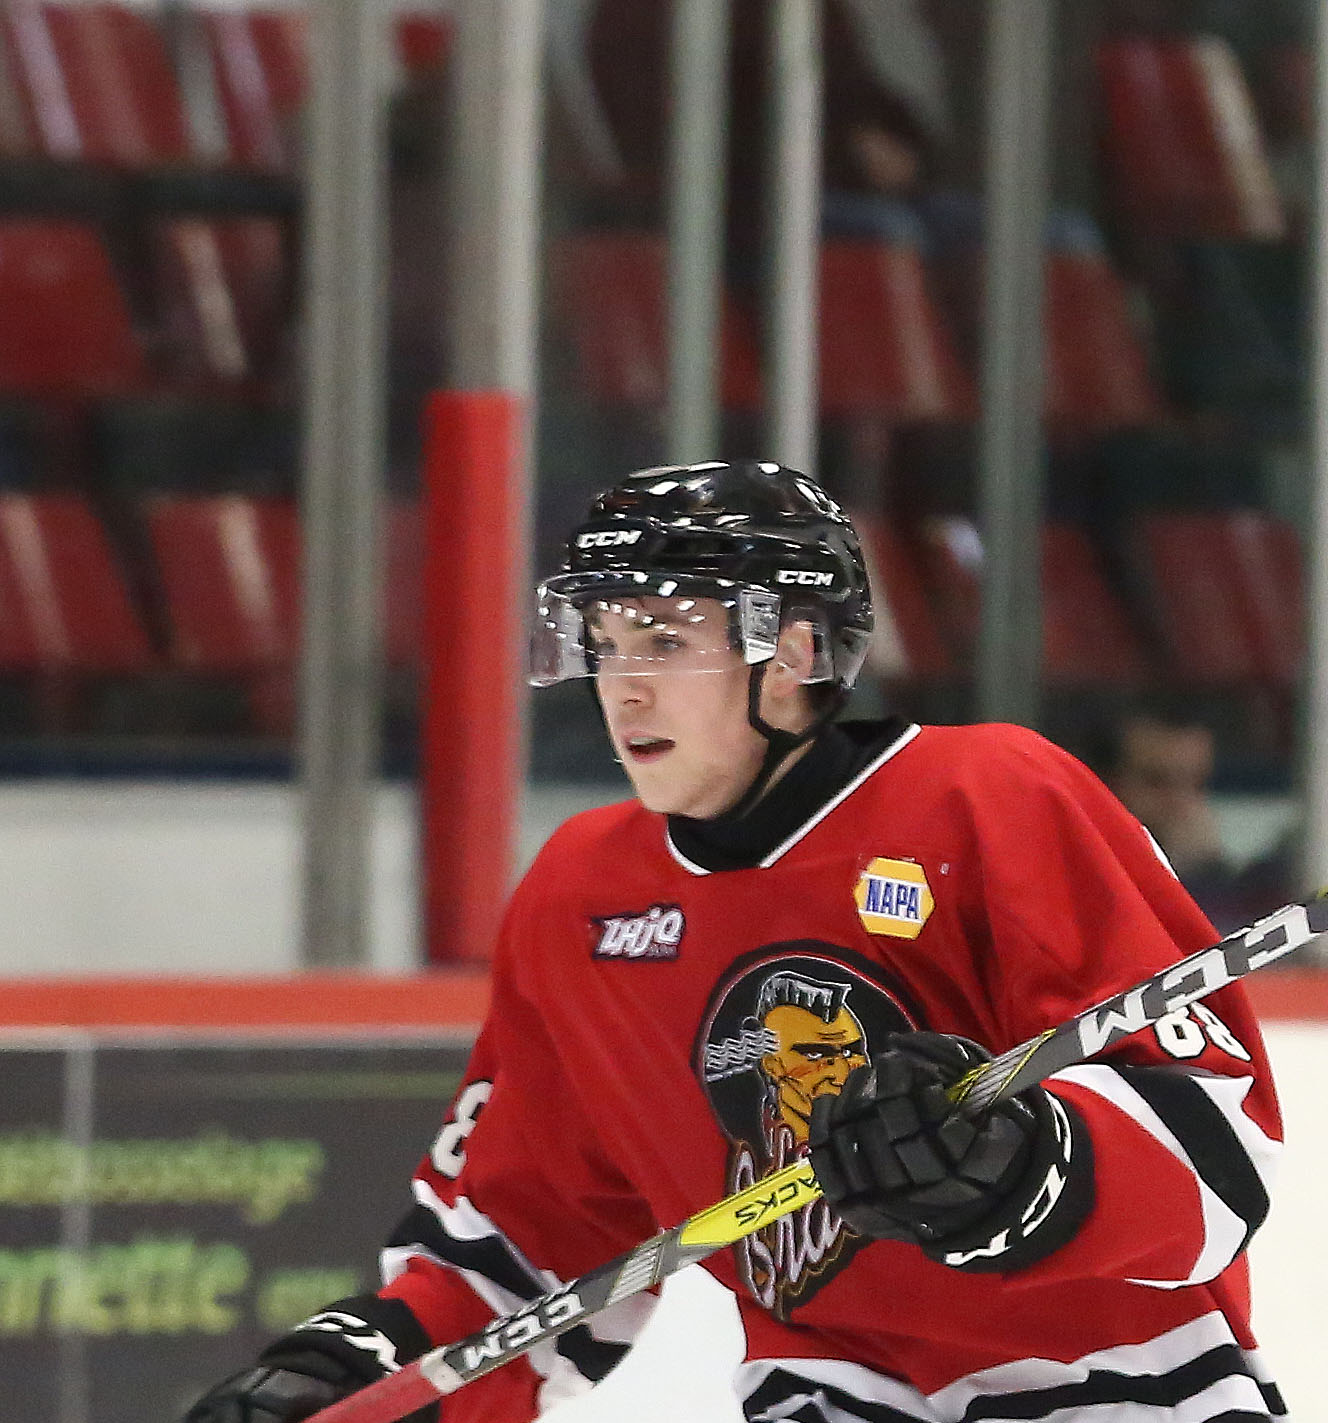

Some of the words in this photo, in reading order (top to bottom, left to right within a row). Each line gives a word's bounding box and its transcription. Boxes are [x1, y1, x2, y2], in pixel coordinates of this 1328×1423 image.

[576, 529, 642, 551] CCM
[778, 569, 835, 587] CCM
[865, 877, 920, 921] NAPA
[1077, 902, 1320, 1060] CCM
[735, 1177, 823, 1229] ACKS
[463, 1292, 586, 1371] CCM
